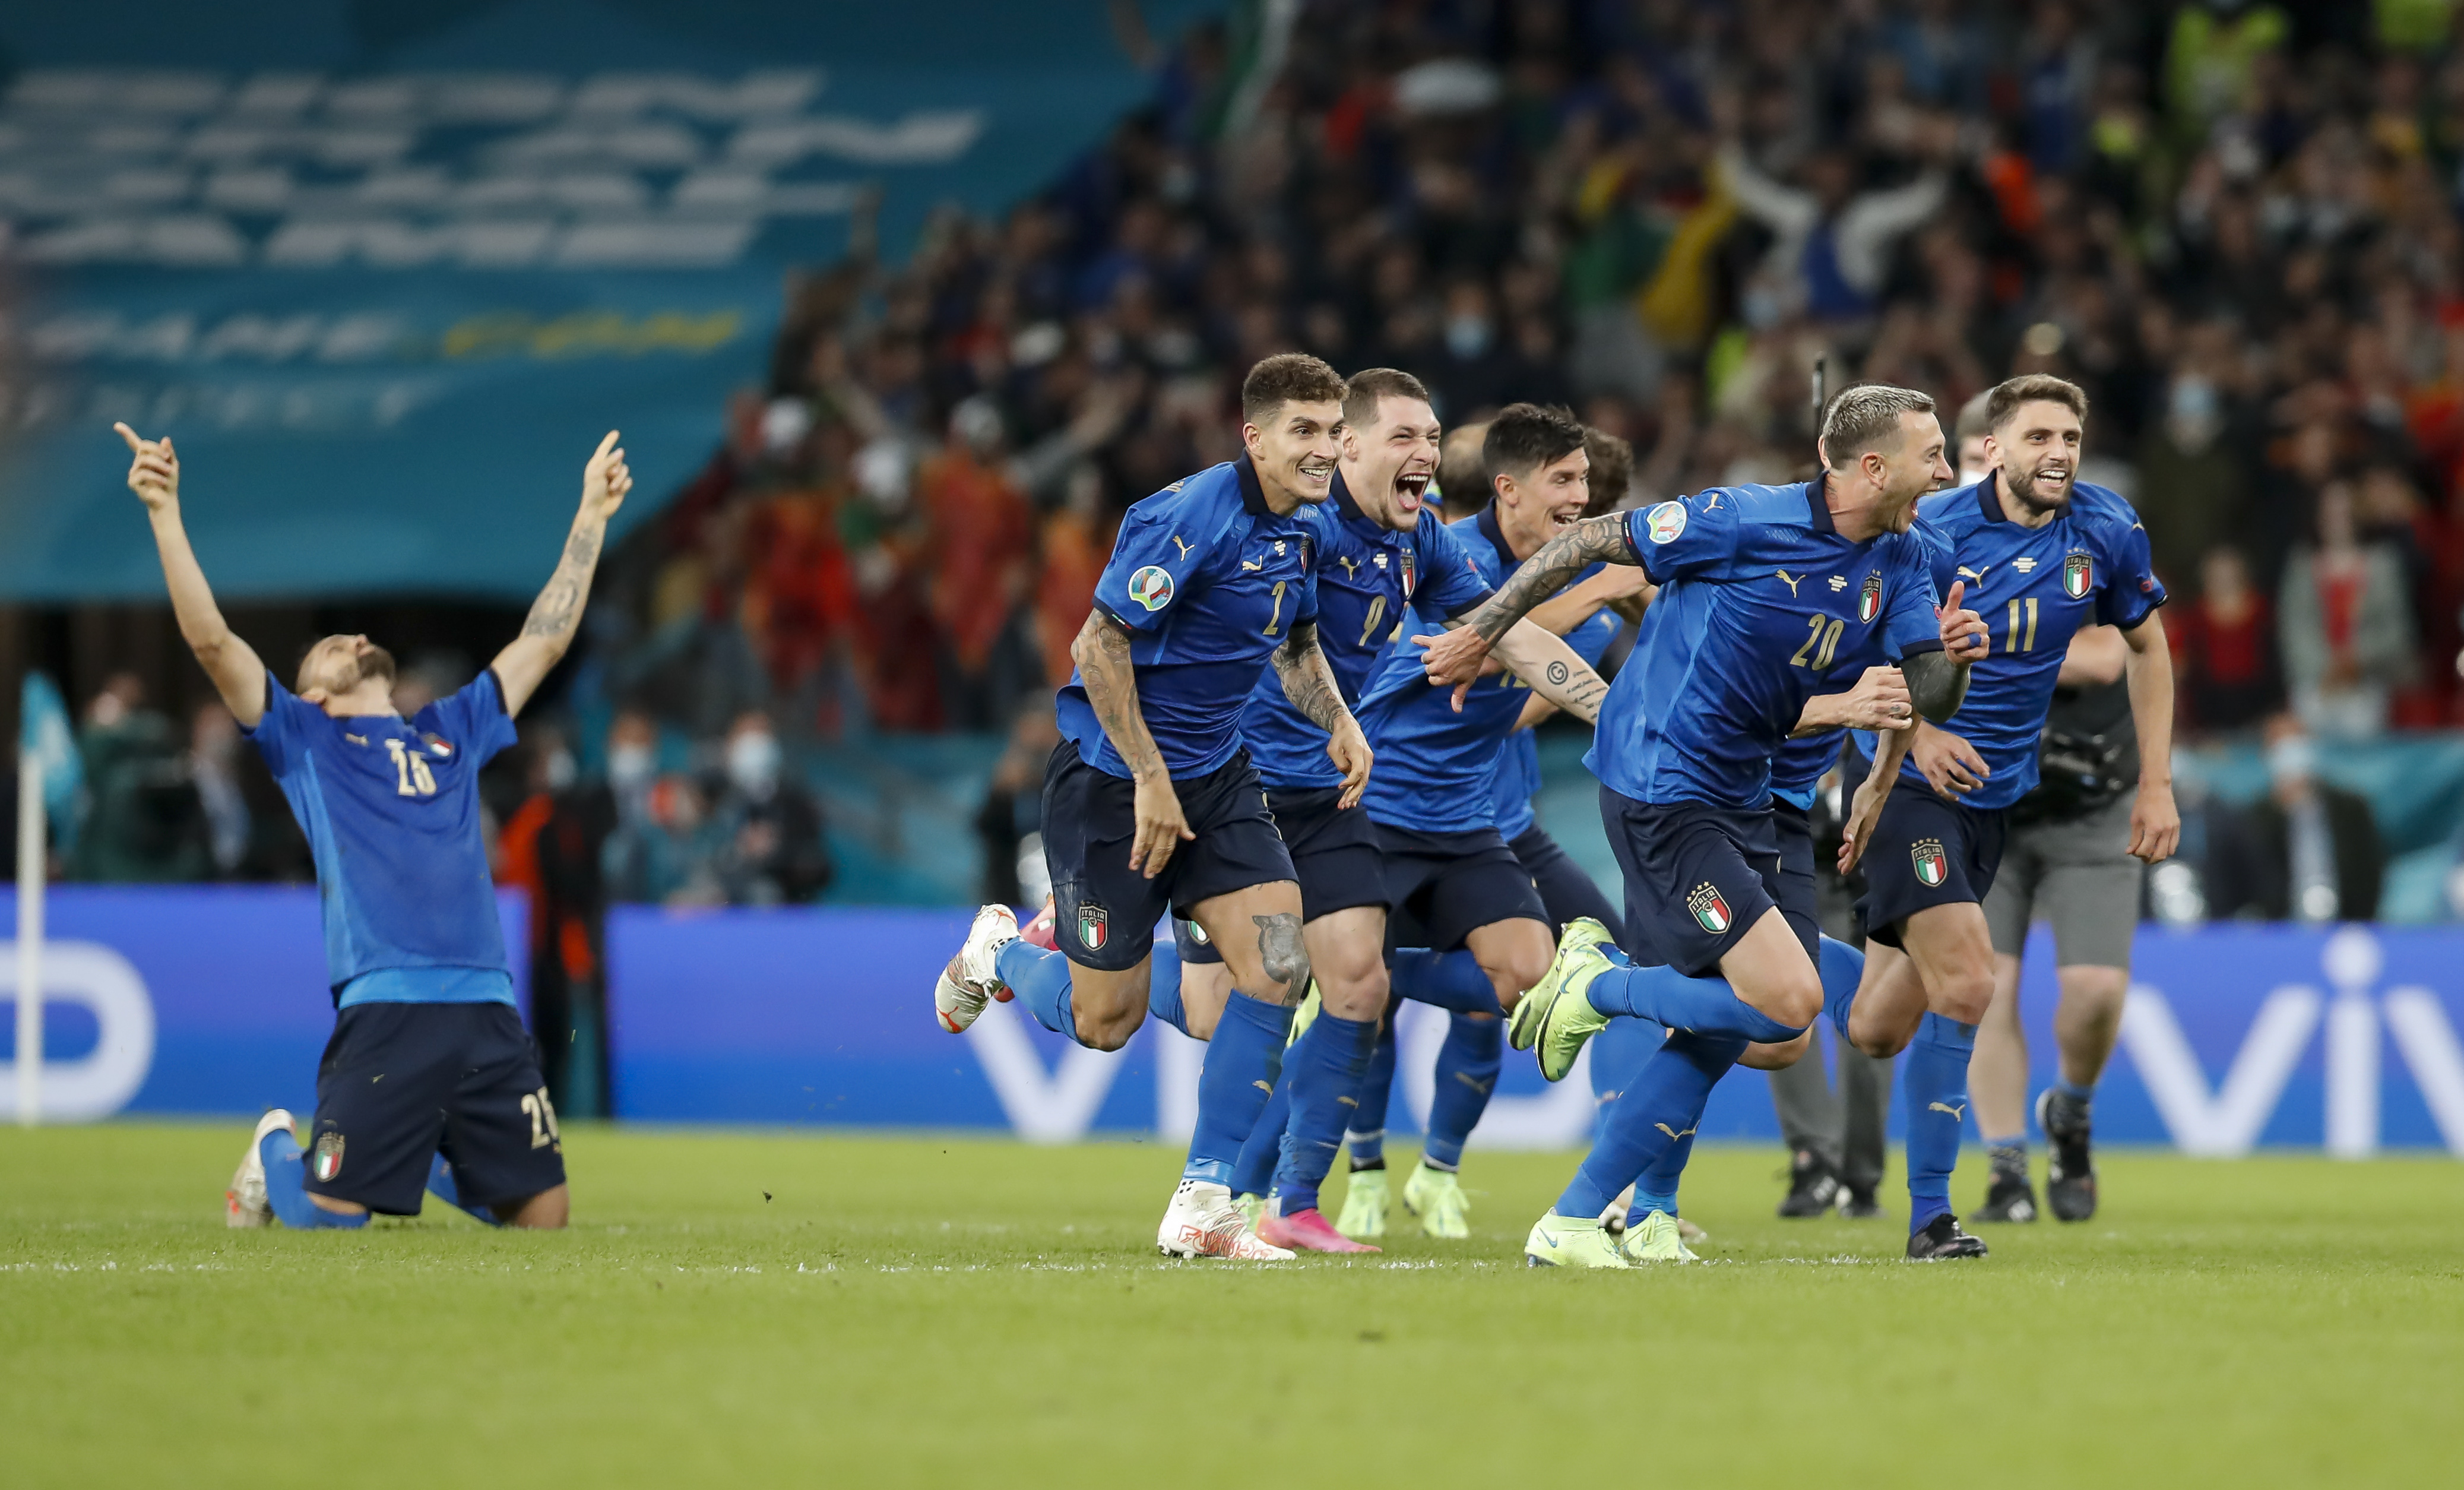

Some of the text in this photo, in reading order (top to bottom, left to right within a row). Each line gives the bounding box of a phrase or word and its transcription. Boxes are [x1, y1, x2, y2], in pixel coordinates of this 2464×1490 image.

[2067, 557, 2089, 565] ITALIA
[1863, 580, 1880, 589] ITALIA
[1262, 581, 1286, 635] 2
[1358, 595, 1387, 647] 9
[2005, 597, 2038, 653] 11
[1790, 613, 1844, 671] 20
[1915, 846, 1941, 858] ITALIA
[1692, 890, 1715, 911] ITALIA
[1082, 910, 1105, 920] ITALIA
